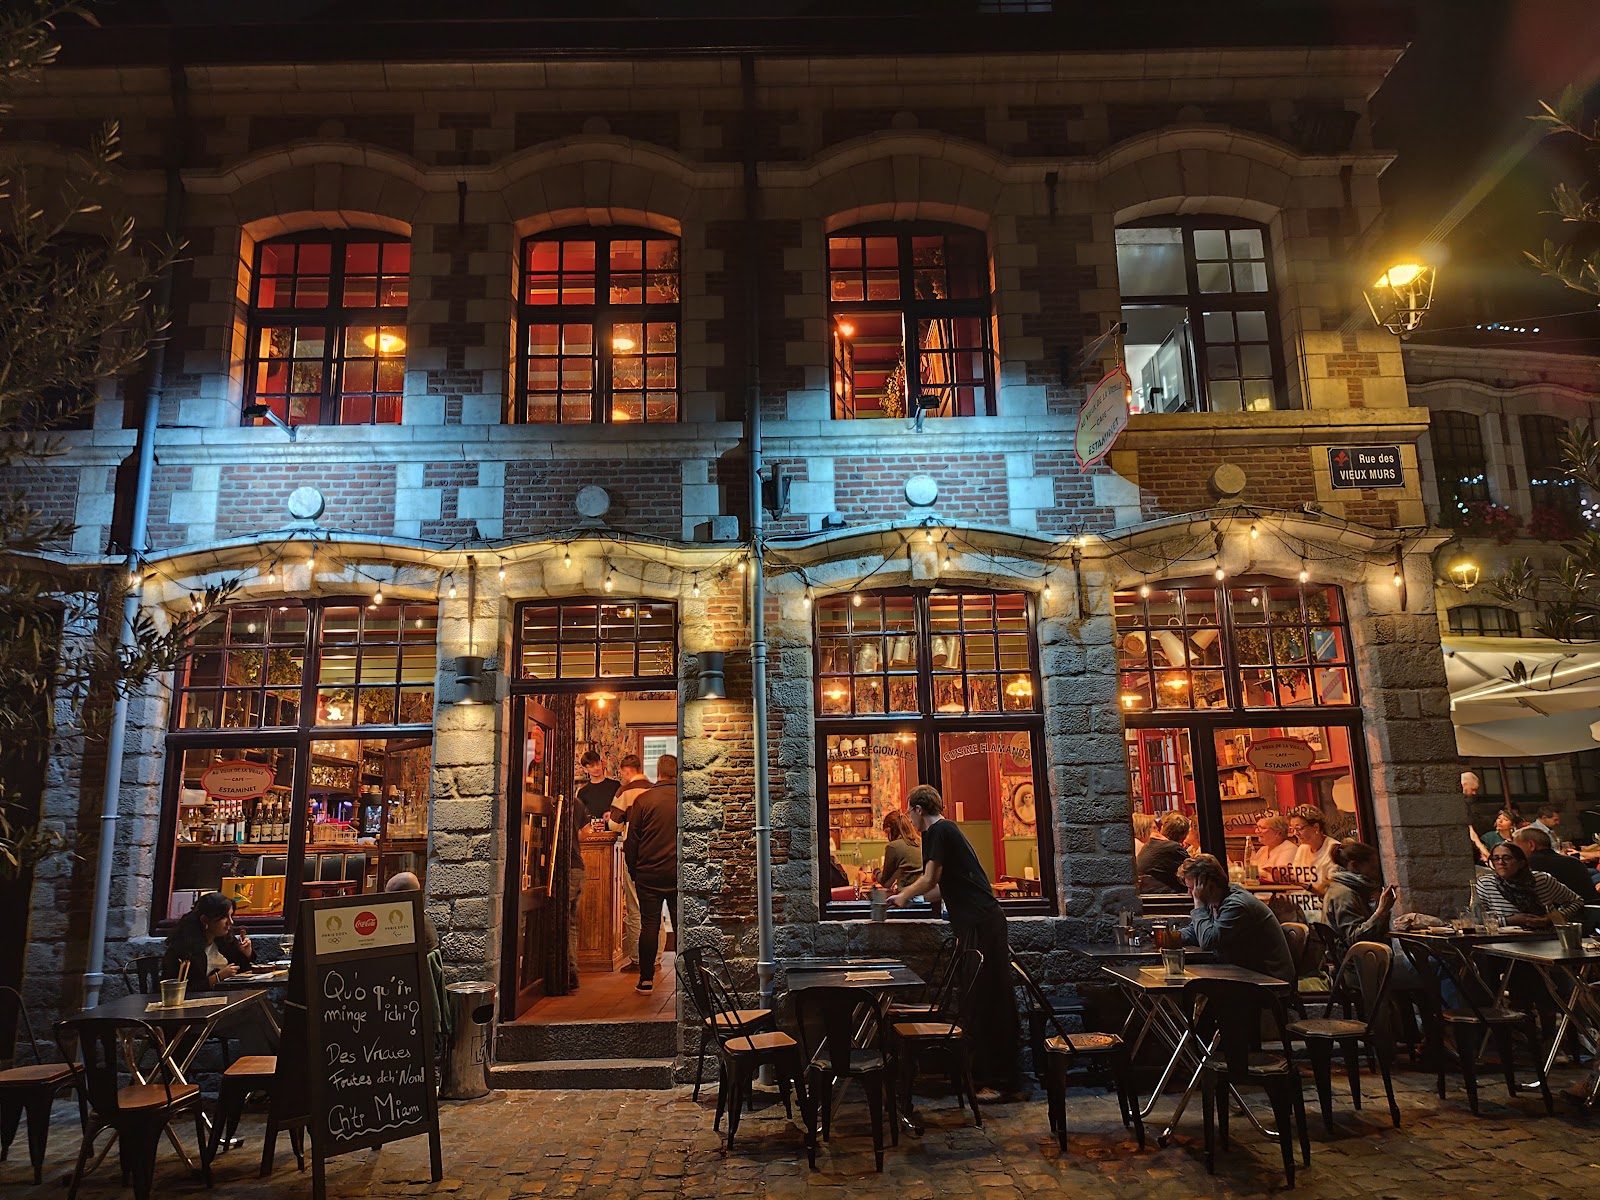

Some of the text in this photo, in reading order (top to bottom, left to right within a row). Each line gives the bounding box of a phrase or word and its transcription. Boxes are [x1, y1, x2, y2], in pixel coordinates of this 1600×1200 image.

[1088, 416, 1119, 455] ESTAMINET
[1359, 453, 1395, 464] Rue des
[1340, 469, 1396, 480] VIEUX MURS
[943, 742, 1031, 762] CUISINE FLAMANDE
[1264, 760, 1301, 768] ESTAMINET
[219, 785, 257, 793] ESTAMINET
[1271, 862, 1318, 883] CRÊPES
[324, 1004, 367, 1034] minge
[326, 1043, 357, 1066] Des
[374, 1092, 420, 1121] Miam
